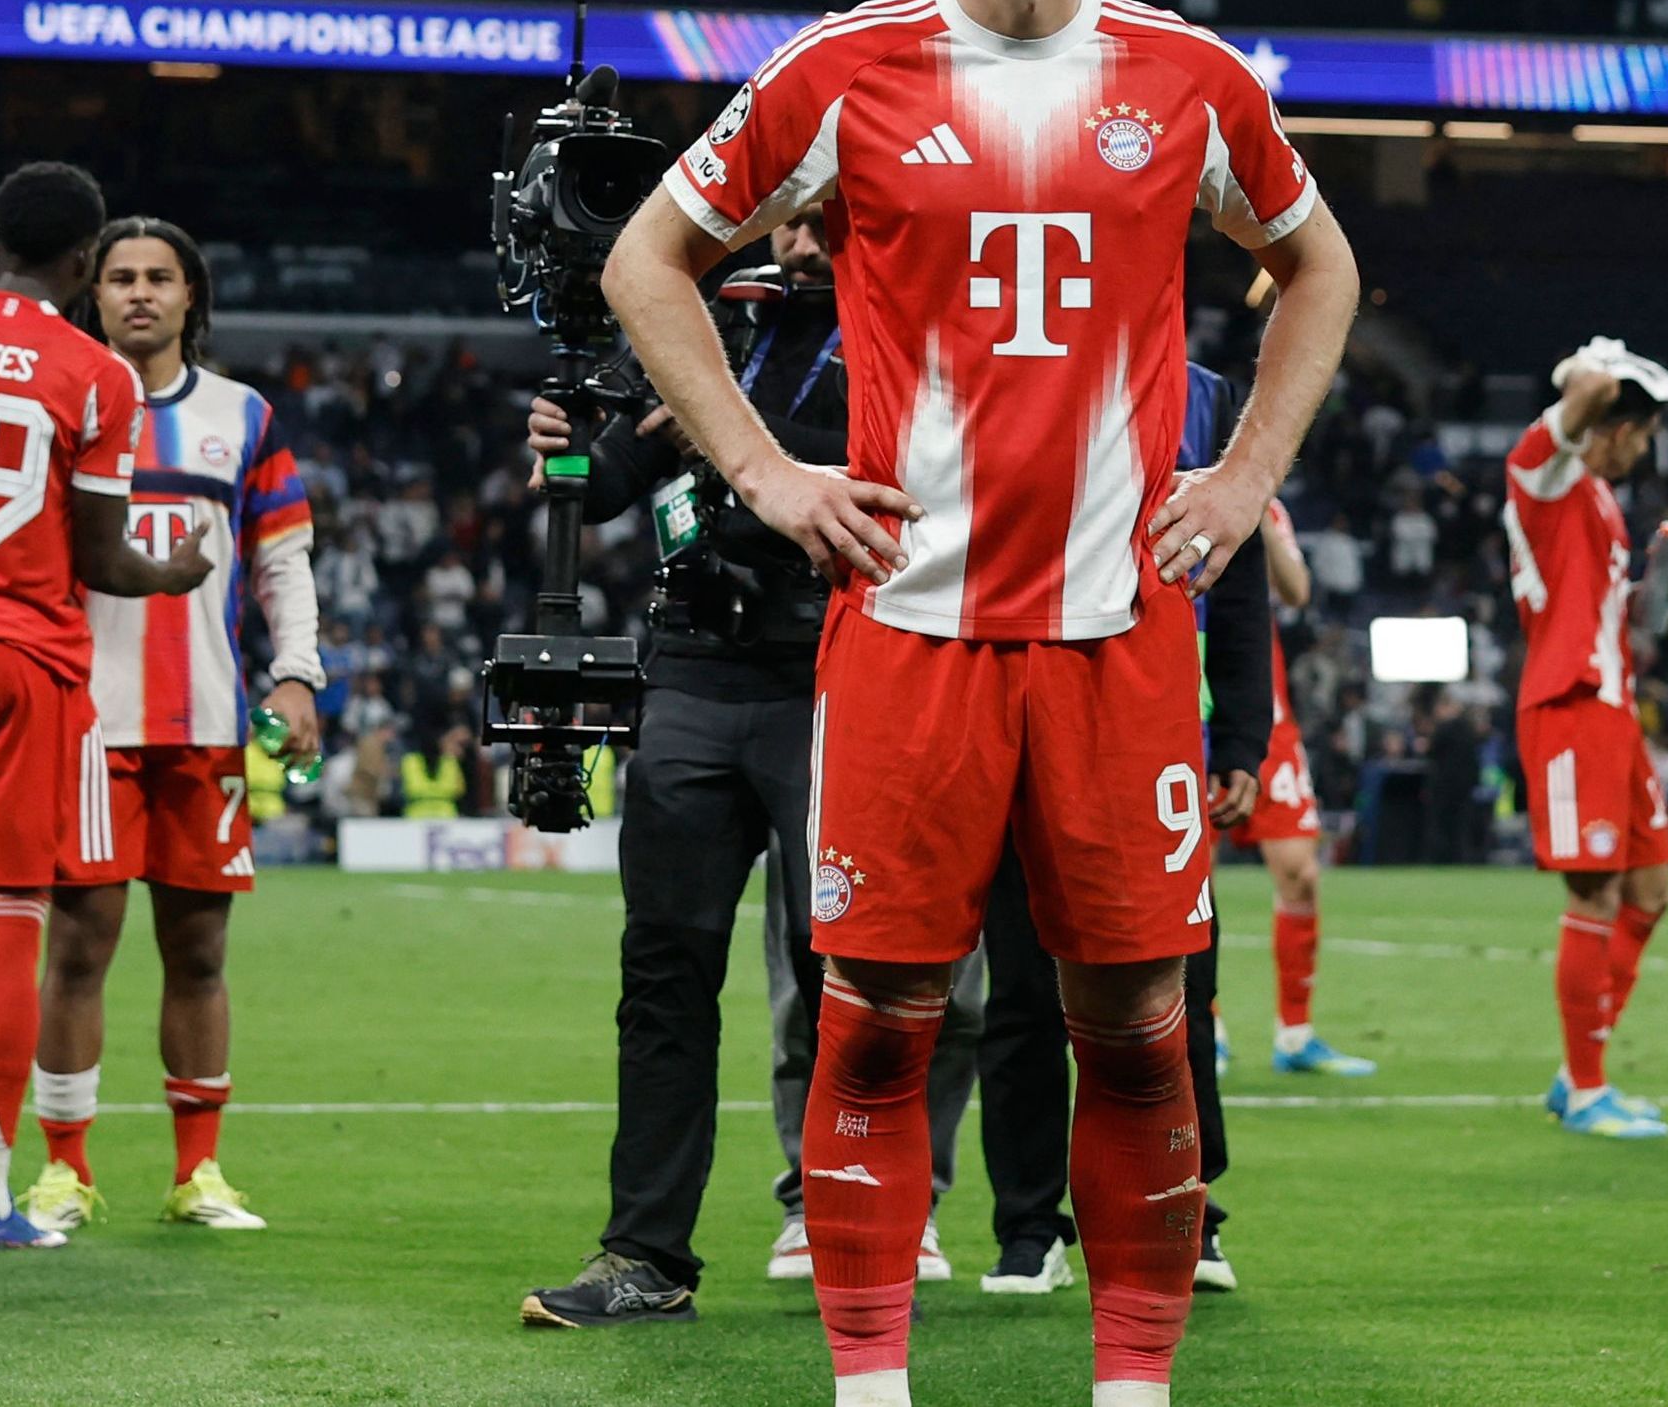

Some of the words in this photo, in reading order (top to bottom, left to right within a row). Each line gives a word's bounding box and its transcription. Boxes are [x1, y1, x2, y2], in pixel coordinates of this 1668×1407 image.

[23, 2, 134, 45] UEFA
[140, 7, 393, 57] CHAMPIONS
[399, 18, 561, 62] LEAGUE
[1112, 123, 1147, 144] BAYERN
[969, 212, 1092, 357] T
[217, 775, 245, 844] 7
[1155, 763, 1202, 873] 9
